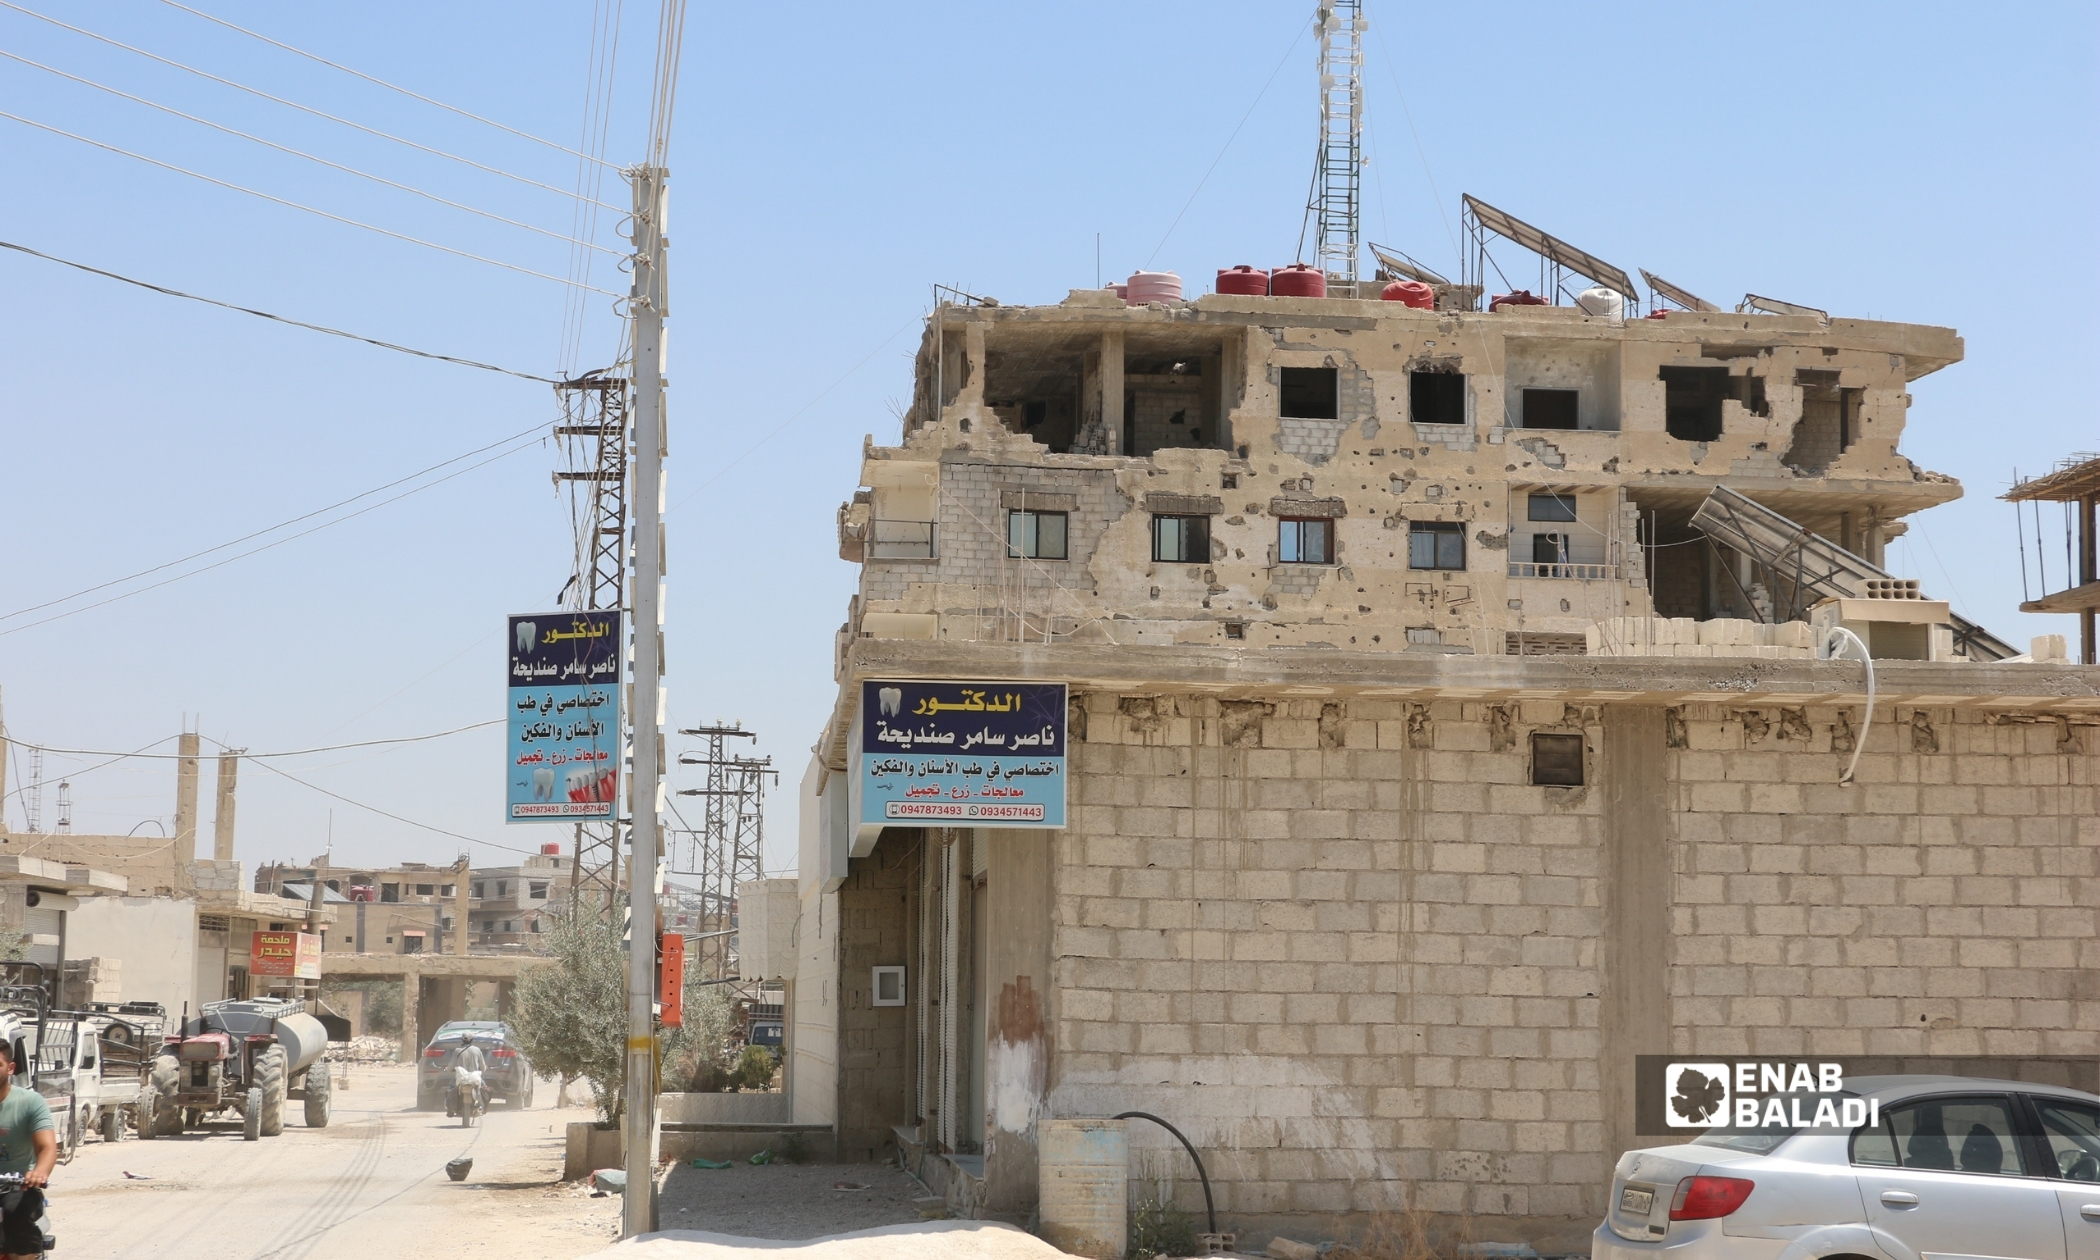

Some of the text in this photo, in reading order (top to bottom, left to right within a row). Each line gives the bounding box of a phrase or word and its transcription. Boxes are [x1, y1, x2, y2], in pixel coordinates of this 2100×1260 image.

[541, 621, 610, 644] الدكتور
[512, 653, 616, 682] ناصر سامر صنديحة
[517, 690, 610, 717] اختصاصي في طب
[911, 689, 1021, 715] الدكتور
[521, 718, 604, 743] الأسنان والفكين
[876, 720, 1055, 751] ناصر سامر صنديحة
[516, 748, 609, 766] معالجات زرع تجميل
[870, 757, 1059, 782] اختصاصي في طب الأسنان والفكين
[904, 783, 940, 798] تجميل
[951, 784, 970, 799] زرع
[981, 783, 1024, 798] معالجات
[520, 804, 609, 814] 0947873493 0934571443
[900, 804, 1042, 817] 0947873493 0934571443
[260, 934, 290, 945] ملحمة
[257, 946, 293, 960] حيدر
